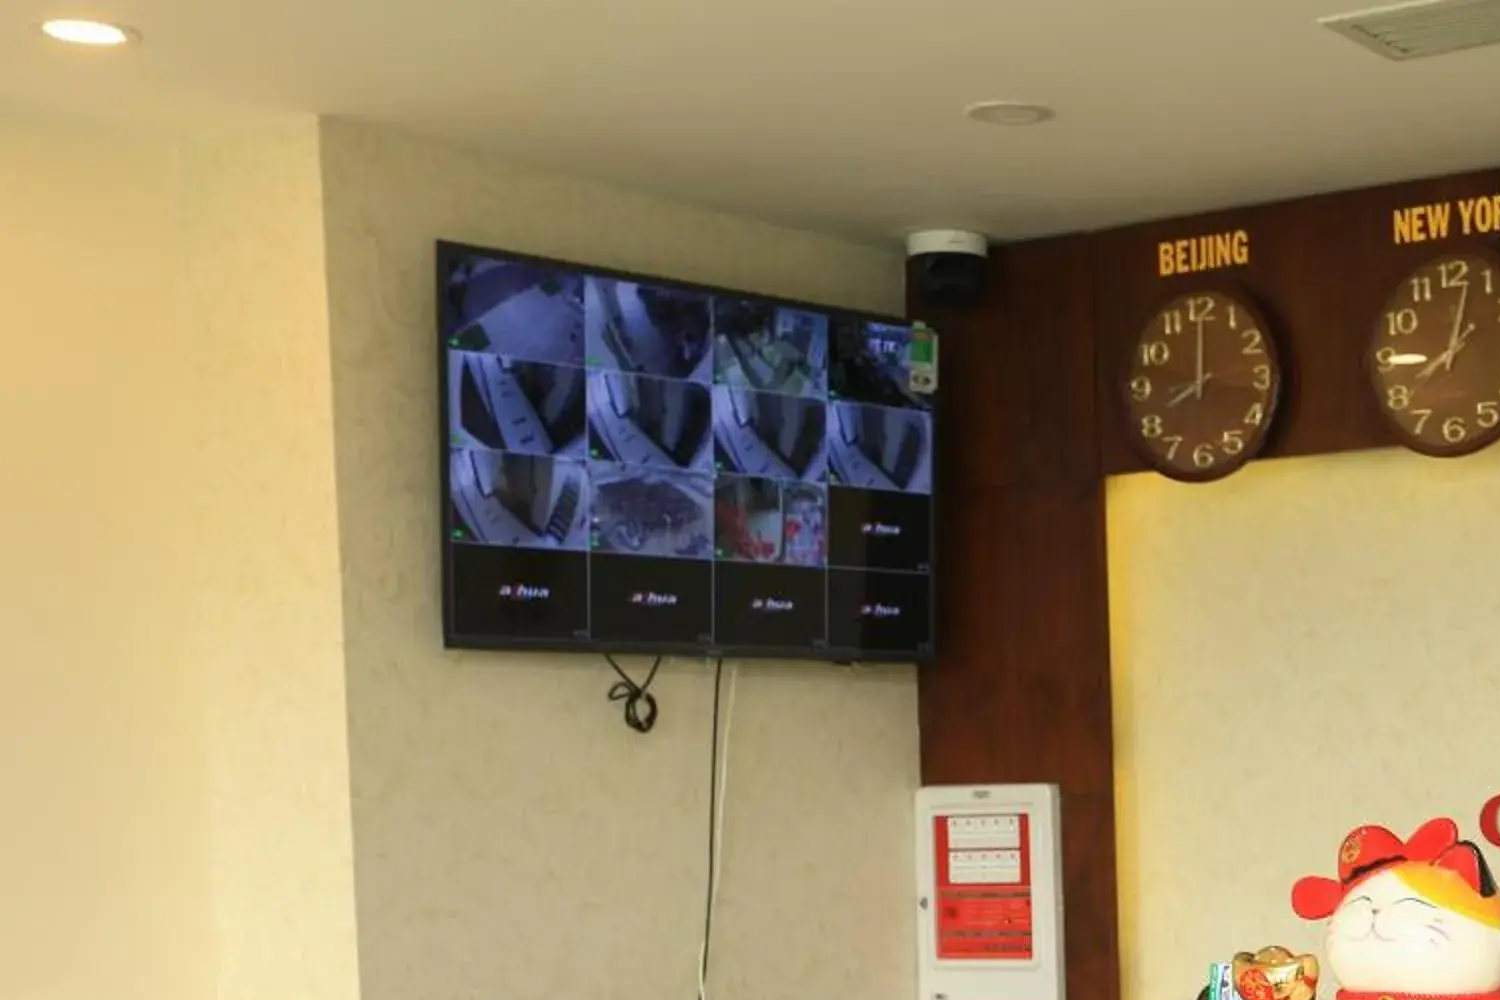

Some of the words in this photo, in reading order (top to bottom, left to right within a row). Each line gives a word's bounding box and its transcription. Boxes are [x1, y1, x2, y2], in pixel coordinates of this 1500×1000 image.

[1393, 203, 1450, 244] NEW
[1159, 230, 1249, 277] BEIJING
[1438, 260, 1468, 287] 12
[1481, 269, 1493, 293] 1
[1411, 278, 1430, 301] 11
[1186, 297, 1216, 322] 12
[1226, 305, 1237, 329] 1
[1164, 312, 1182, 334] 11
[1387, 309, 1417, 335] 10
[1141, 342, 1169, 366] 10
[1242, 330, 1262, 355] 2
[1131, 376, 1151, 400] 9
[1253, 366, 1271, 390] 3
[1388, 387, 1409, 410] 8
[1244, 402, 1263, 425] 4
[1411, 409, 1432, 435] 7
[1476, 402, 1498, 428] 5
[1142, 415, 1161, 437] 8
[1442, 418, 1465, 442] 6
[1163, 436, 1182, 460] 7
[1223, 430, 1243, 455] 5
[1193, 444, 1214, 468] 6
